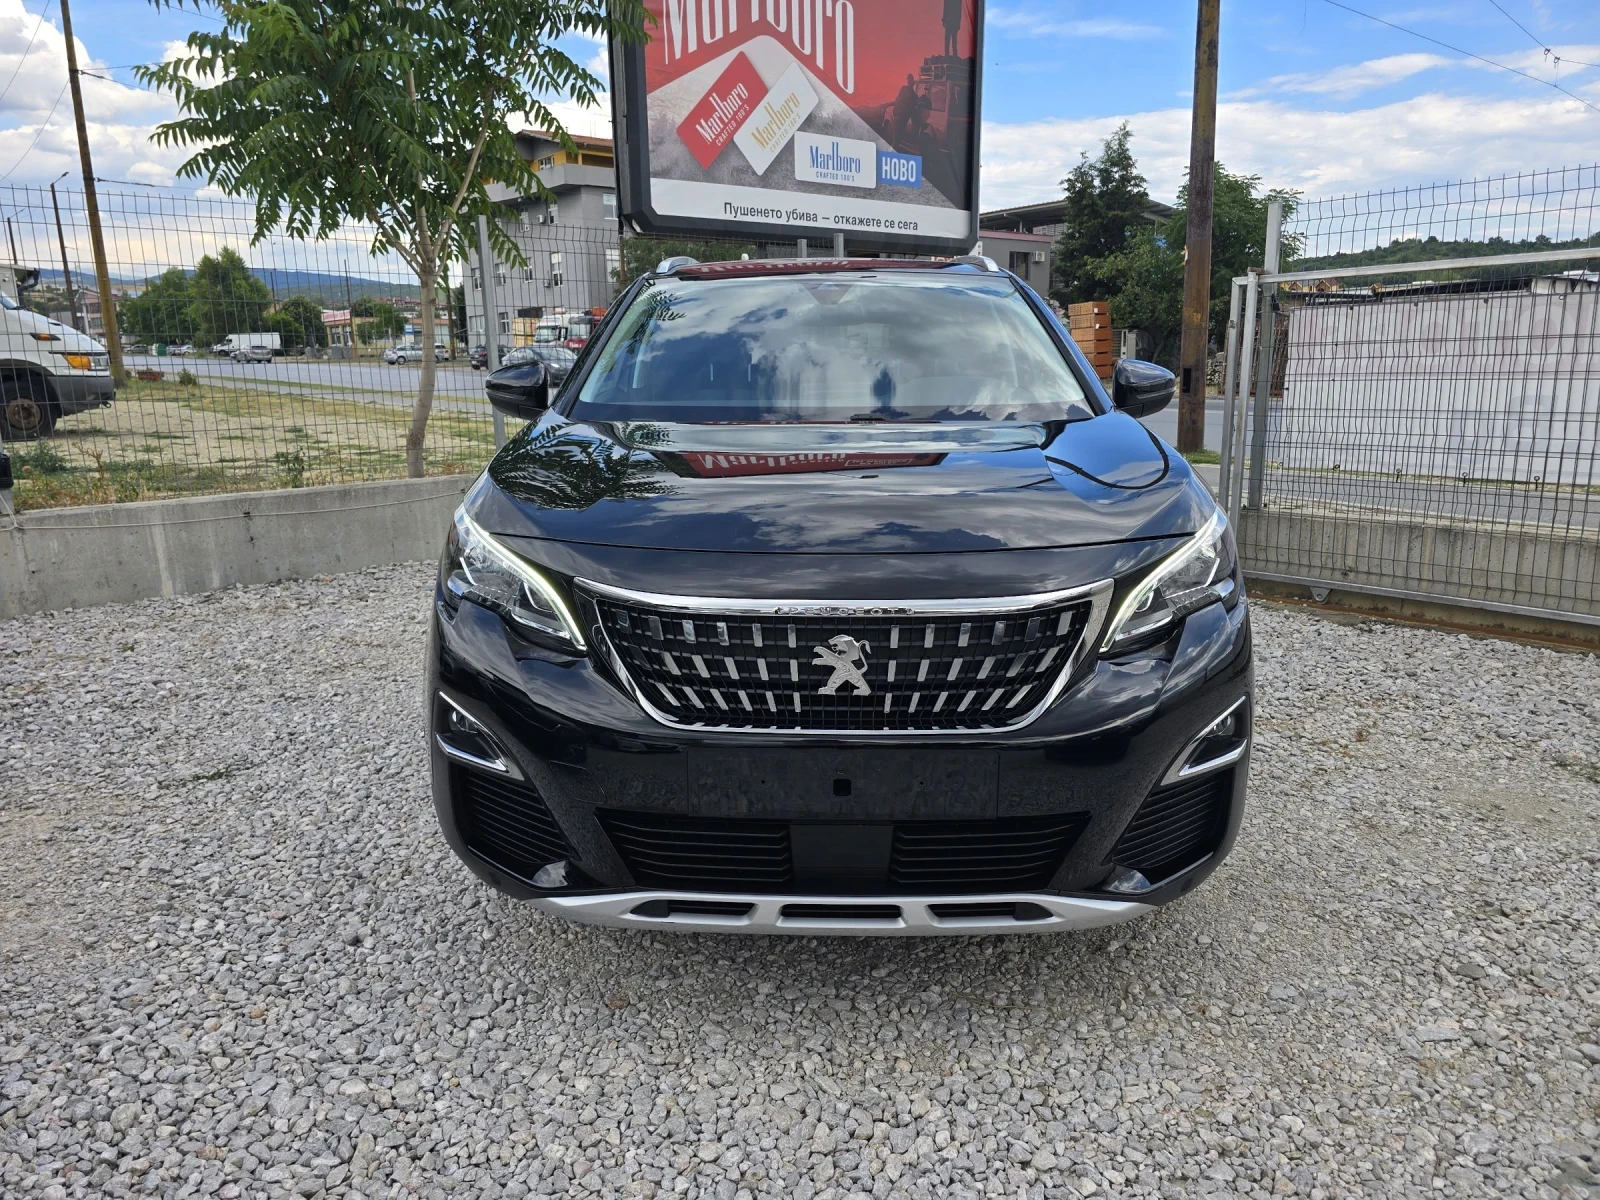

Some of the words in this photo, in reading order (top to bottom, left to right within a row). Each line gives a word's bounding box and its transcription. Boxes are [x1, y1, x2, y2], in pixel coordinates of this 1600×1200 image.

[662, 0, 855, 94] Maoro
[695, 82, 749, 145] Marlboro
[751, 92, 800, 151] Marlboro
[716, 121, 736, 146] CRAFTED
[809, 141, 861, 174] Marlboro
[815, 171, 839, 181] CRAFTED
[723, 202, 783, 219] Пушенето
[785, 208, 818, 223] убива
[833, 213, 882, 228] откажете
[884, 220, 896, 229] се
[897, 220, 919, 231] сега
